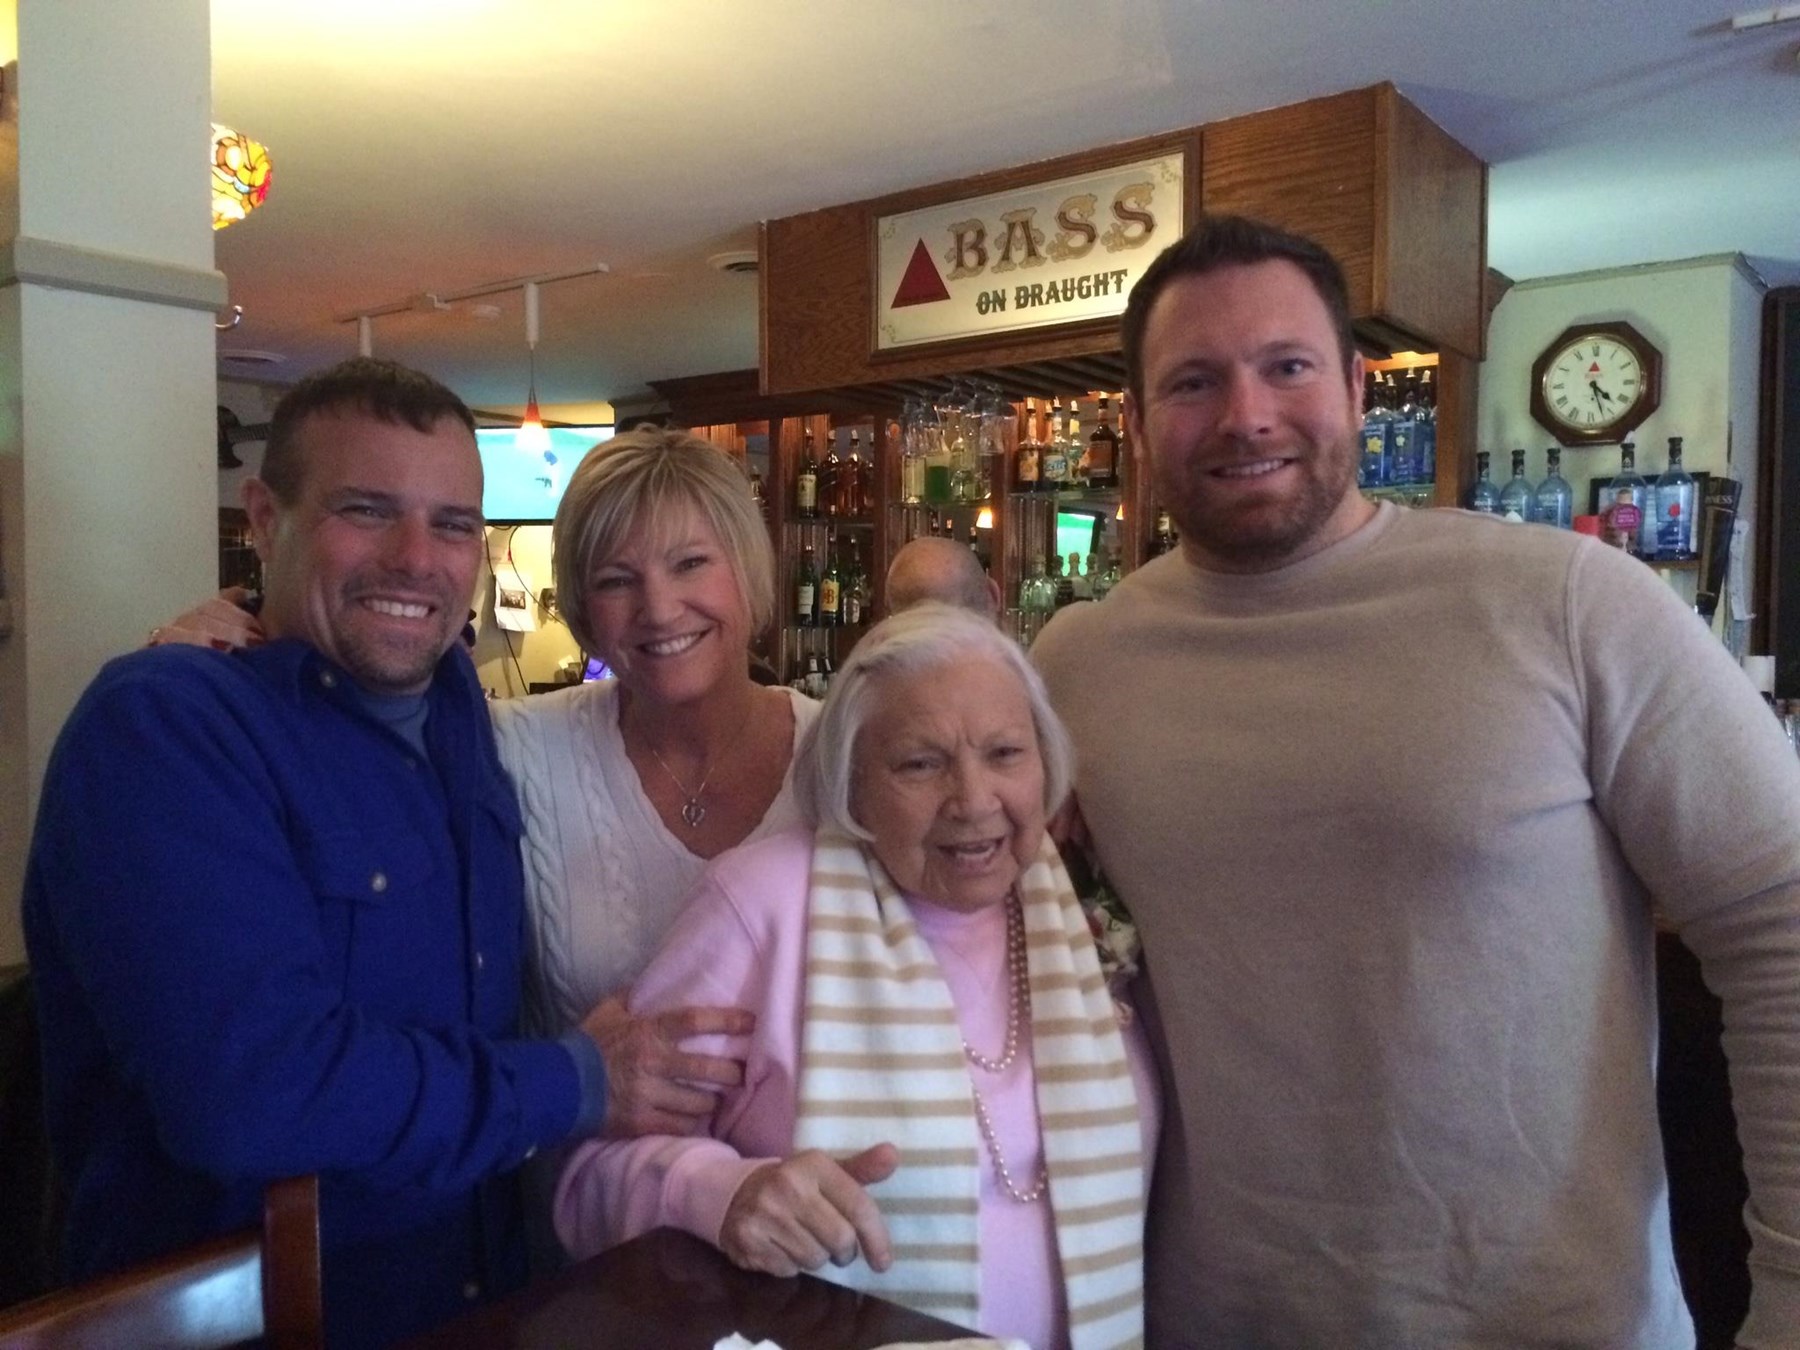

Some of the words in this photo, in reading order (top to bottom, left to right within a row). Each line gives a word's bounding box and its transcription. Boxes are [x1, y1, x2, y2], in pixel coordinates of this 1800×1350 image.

[944, 181, 1158, 281] BASS
[976, 288, 1007, 315] ON
[1014, 268, 1128, 310] DRAUGHT
